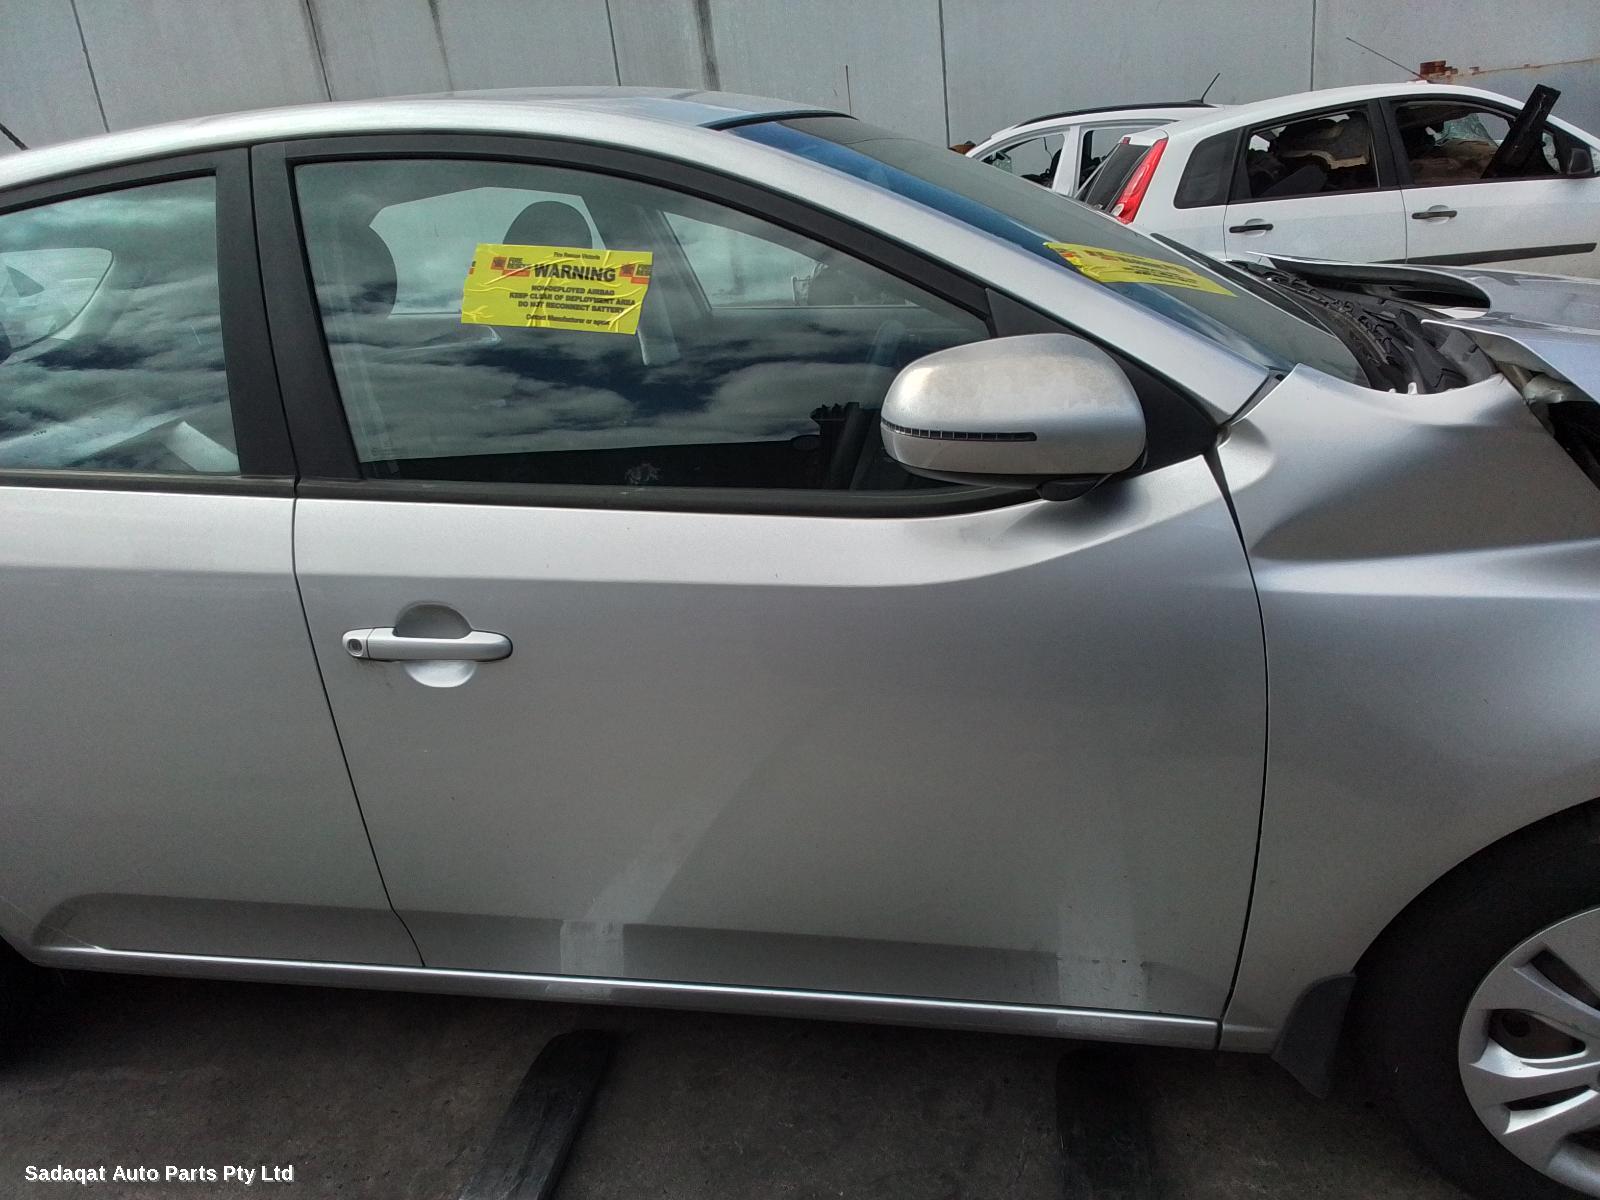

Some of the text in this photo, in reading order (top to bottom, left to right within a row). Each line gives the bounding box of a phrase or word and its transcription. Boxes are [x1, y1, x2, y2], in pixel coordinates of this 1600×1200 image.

[534, 263, 616, 283] WARNING
[587, 288, 615, 296] AIRBAG
[615, 298, 635, 306] AREA
[546, 302, 591, 311] RECONNECT
